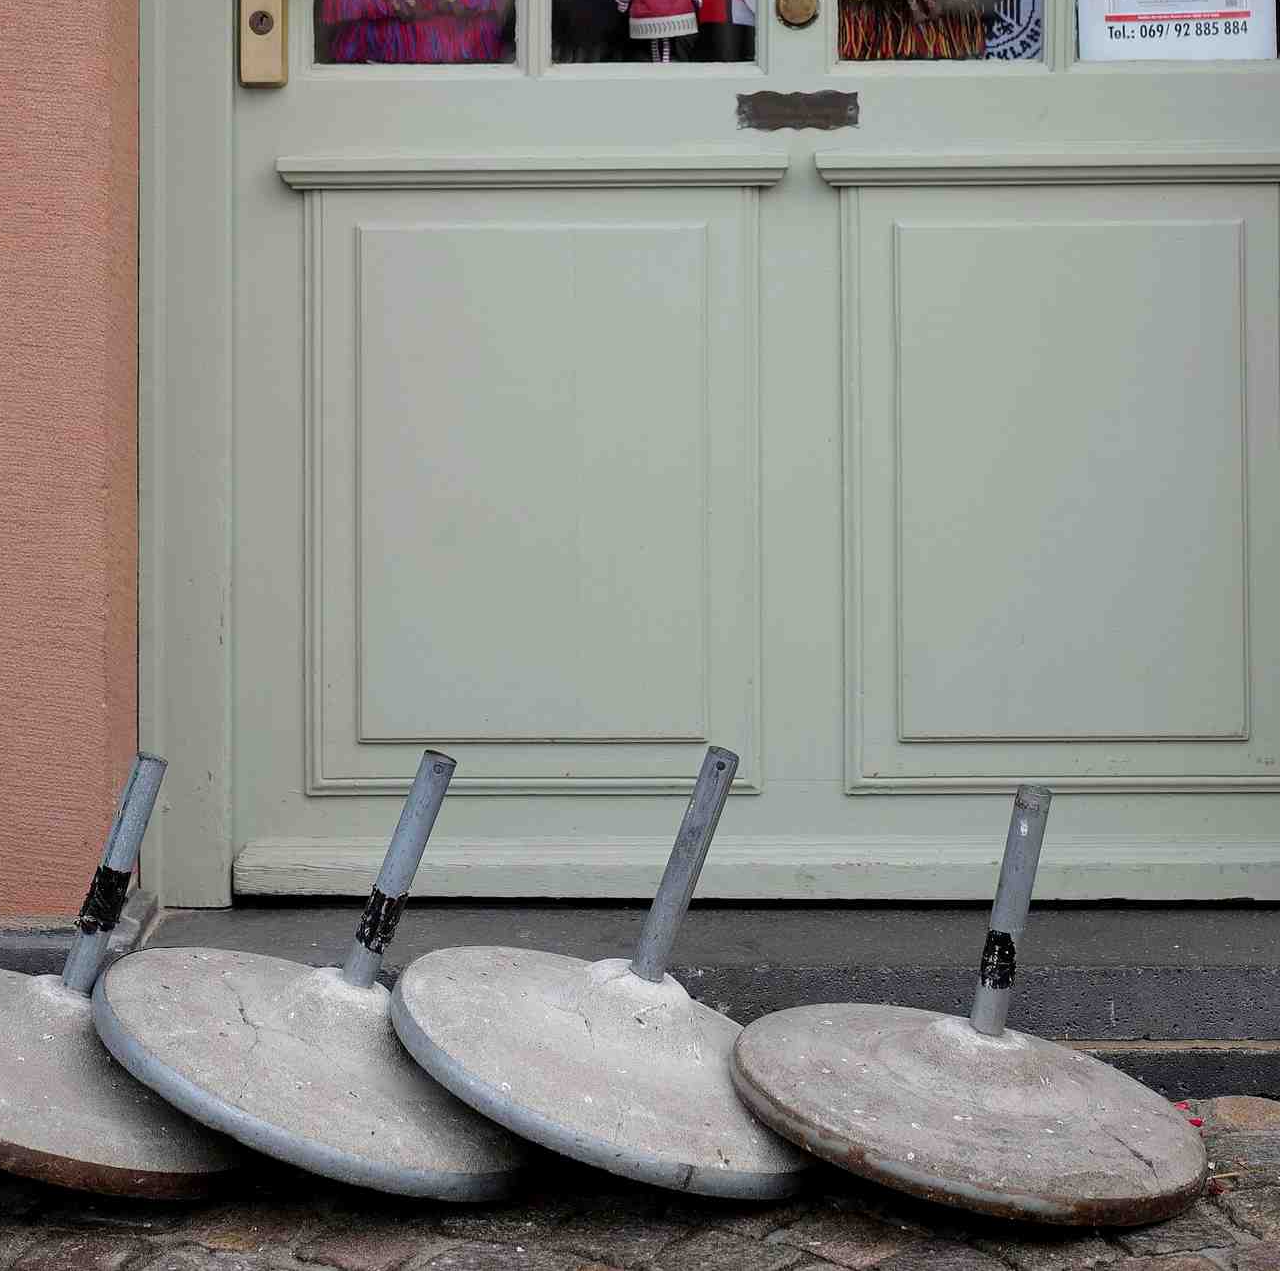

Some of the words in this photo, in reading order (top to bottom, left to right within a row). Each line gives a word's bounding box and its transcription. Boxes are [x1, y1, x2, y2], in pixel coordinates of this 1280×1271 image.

[1107, 25, 1136, 40] Tel.:
[1140, 23, 1170, 40] 069/
[1175, 23, 1191, 37] 92
[1195, 22, 1220, 37] 885
[1224, 20, 1249, 36] 884
